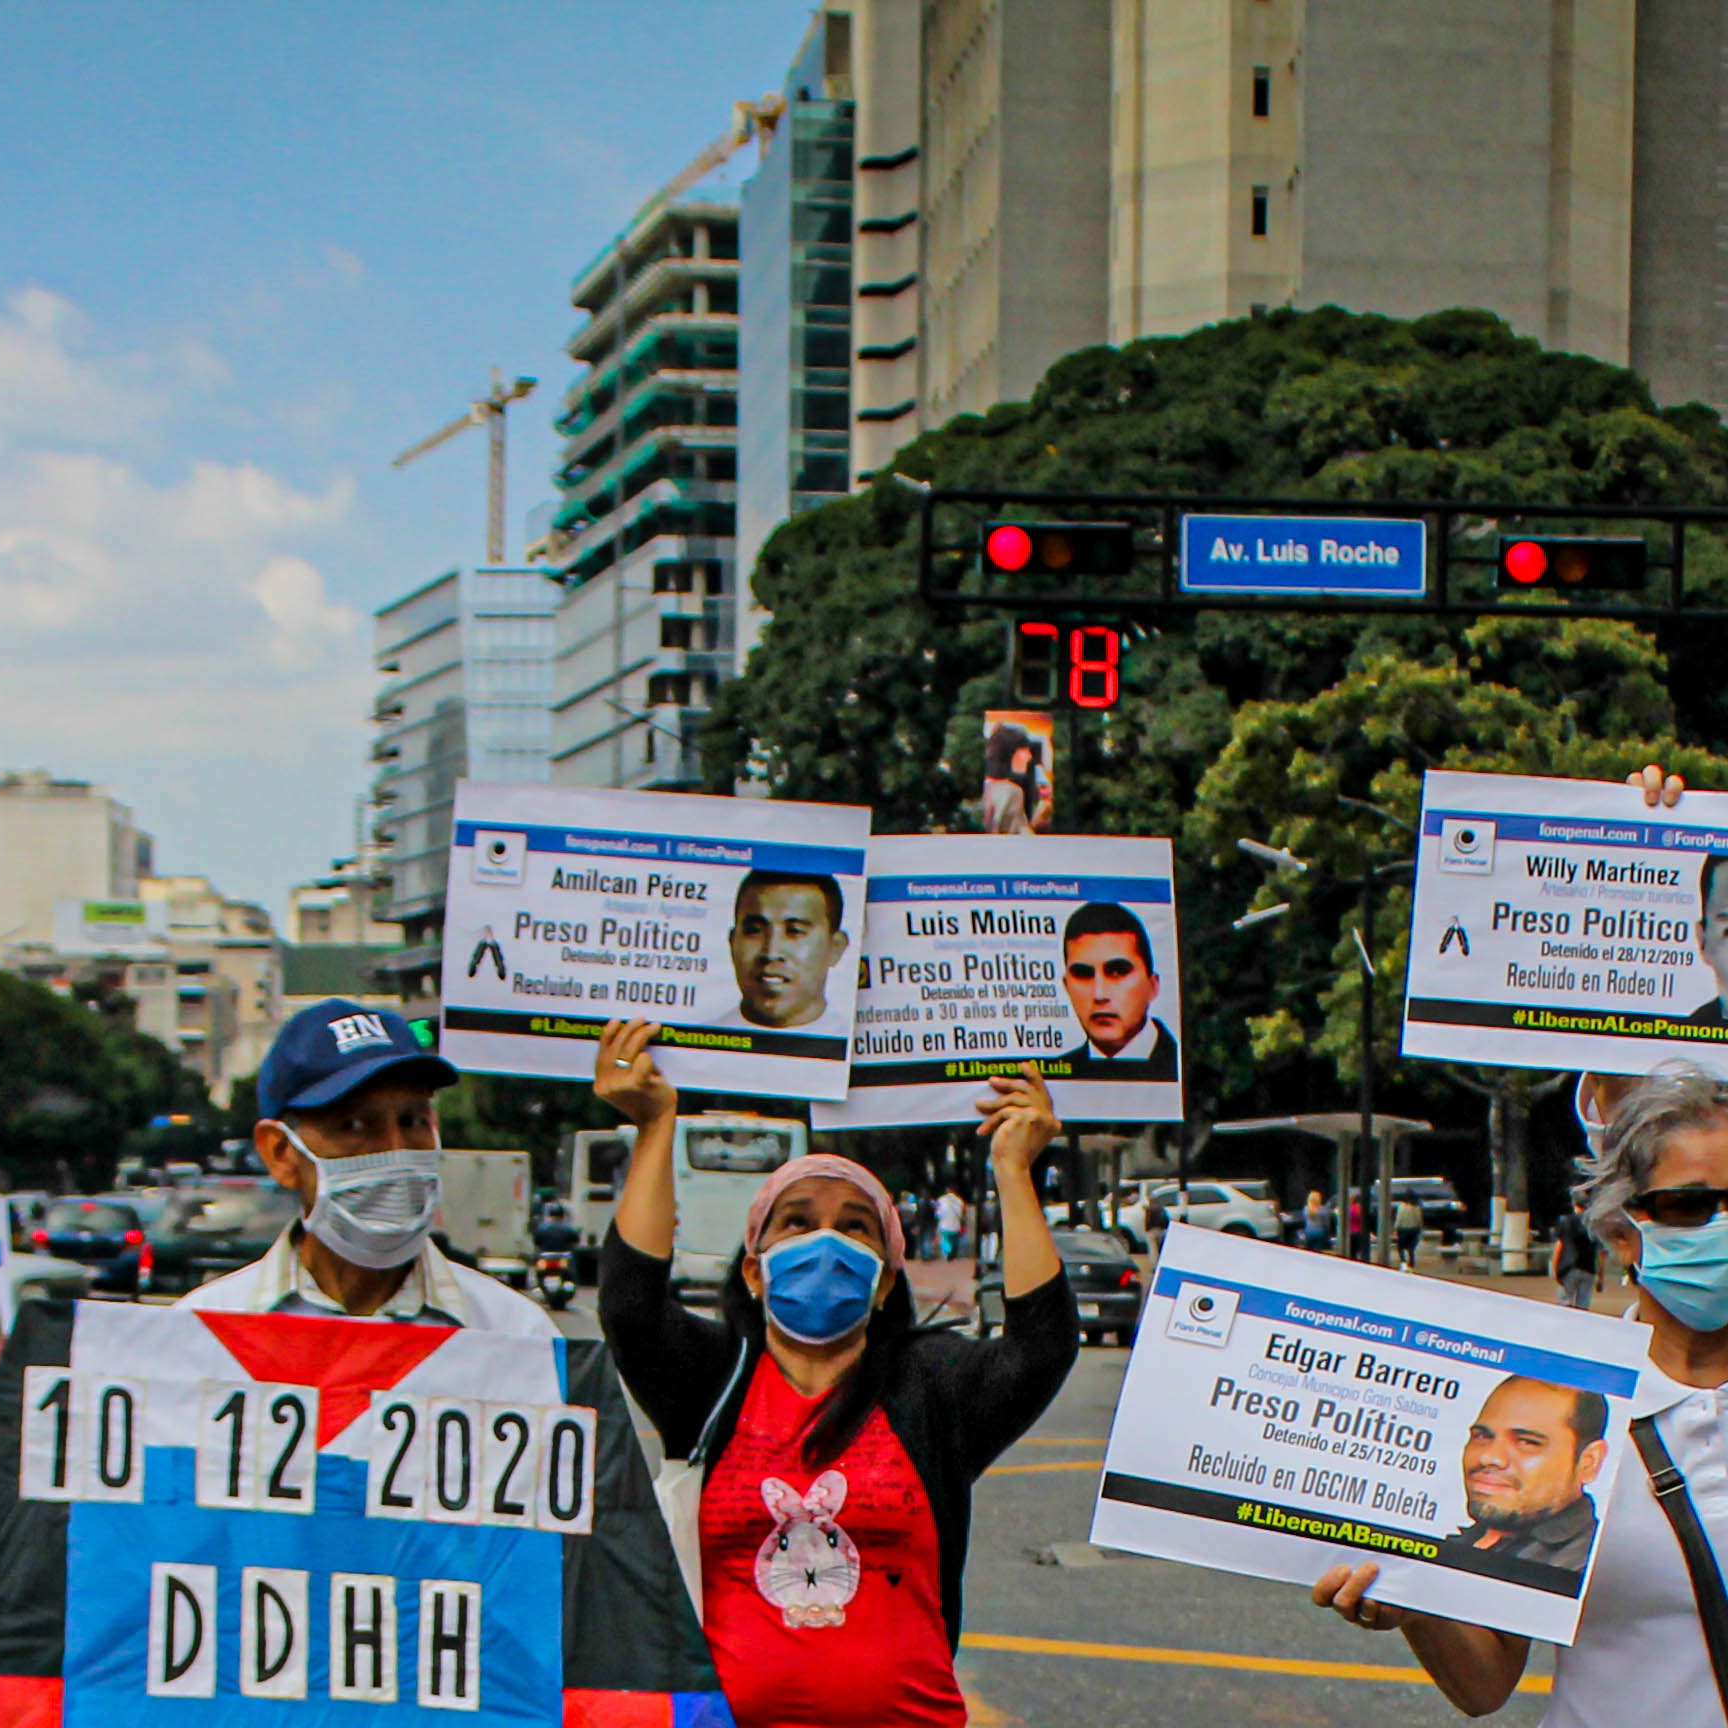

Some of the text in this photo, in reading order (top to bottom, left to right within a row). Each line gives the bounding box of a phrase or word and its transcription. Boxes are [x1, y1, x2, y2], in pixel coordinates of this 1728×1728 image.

[1209, 534, 1400, 569] Av. Luis Roche
[551, 867, 708, 900] Amilcan Pérez
[1526, 856, 1680, 886] Willy Martínez
[515, 912, 700, 952] Preso Político
[906, 909, 1056, 936] Luis Molina
[1492, 902, 1688, 943] Preso Político
[879, 954, 1055, 984] Preso Político
[1541, 941, 1694, 966] Detenido el 28/12/2019
[513, 973, 695, 1006] Recluido en RODEO II
[1506, 962, 1672, 998] Recluido en Rodeo II
[855, 1025, 1063, 1055] cluido en Ramo Verde
[1285, 1304, 1505, 1363] foropenal.com @ForoPenal
[1265, 1334, 1460, 1399] Edgar Barrero
[1249, 1364, 1299, 1391] Concejal
[1365, 1387, 1391, 1405] Gran
[1394, 1393, 1438, 1420] Sabana
[1210, 1377, 1433, 1452] Preso Político
[36, 1378, 135, 1490] 10
[213, 1389, 309, 1500] 12
[380, 1402, 588, 1523] 2020
[1263, 1423, 1437, 1477] Detenido el 25/12/2019
[1189, 1445, 1438, 1522] Recluido en DGCIM Boleíta
[1238, 1502, 1438, 1559] #LiberenABarrero
